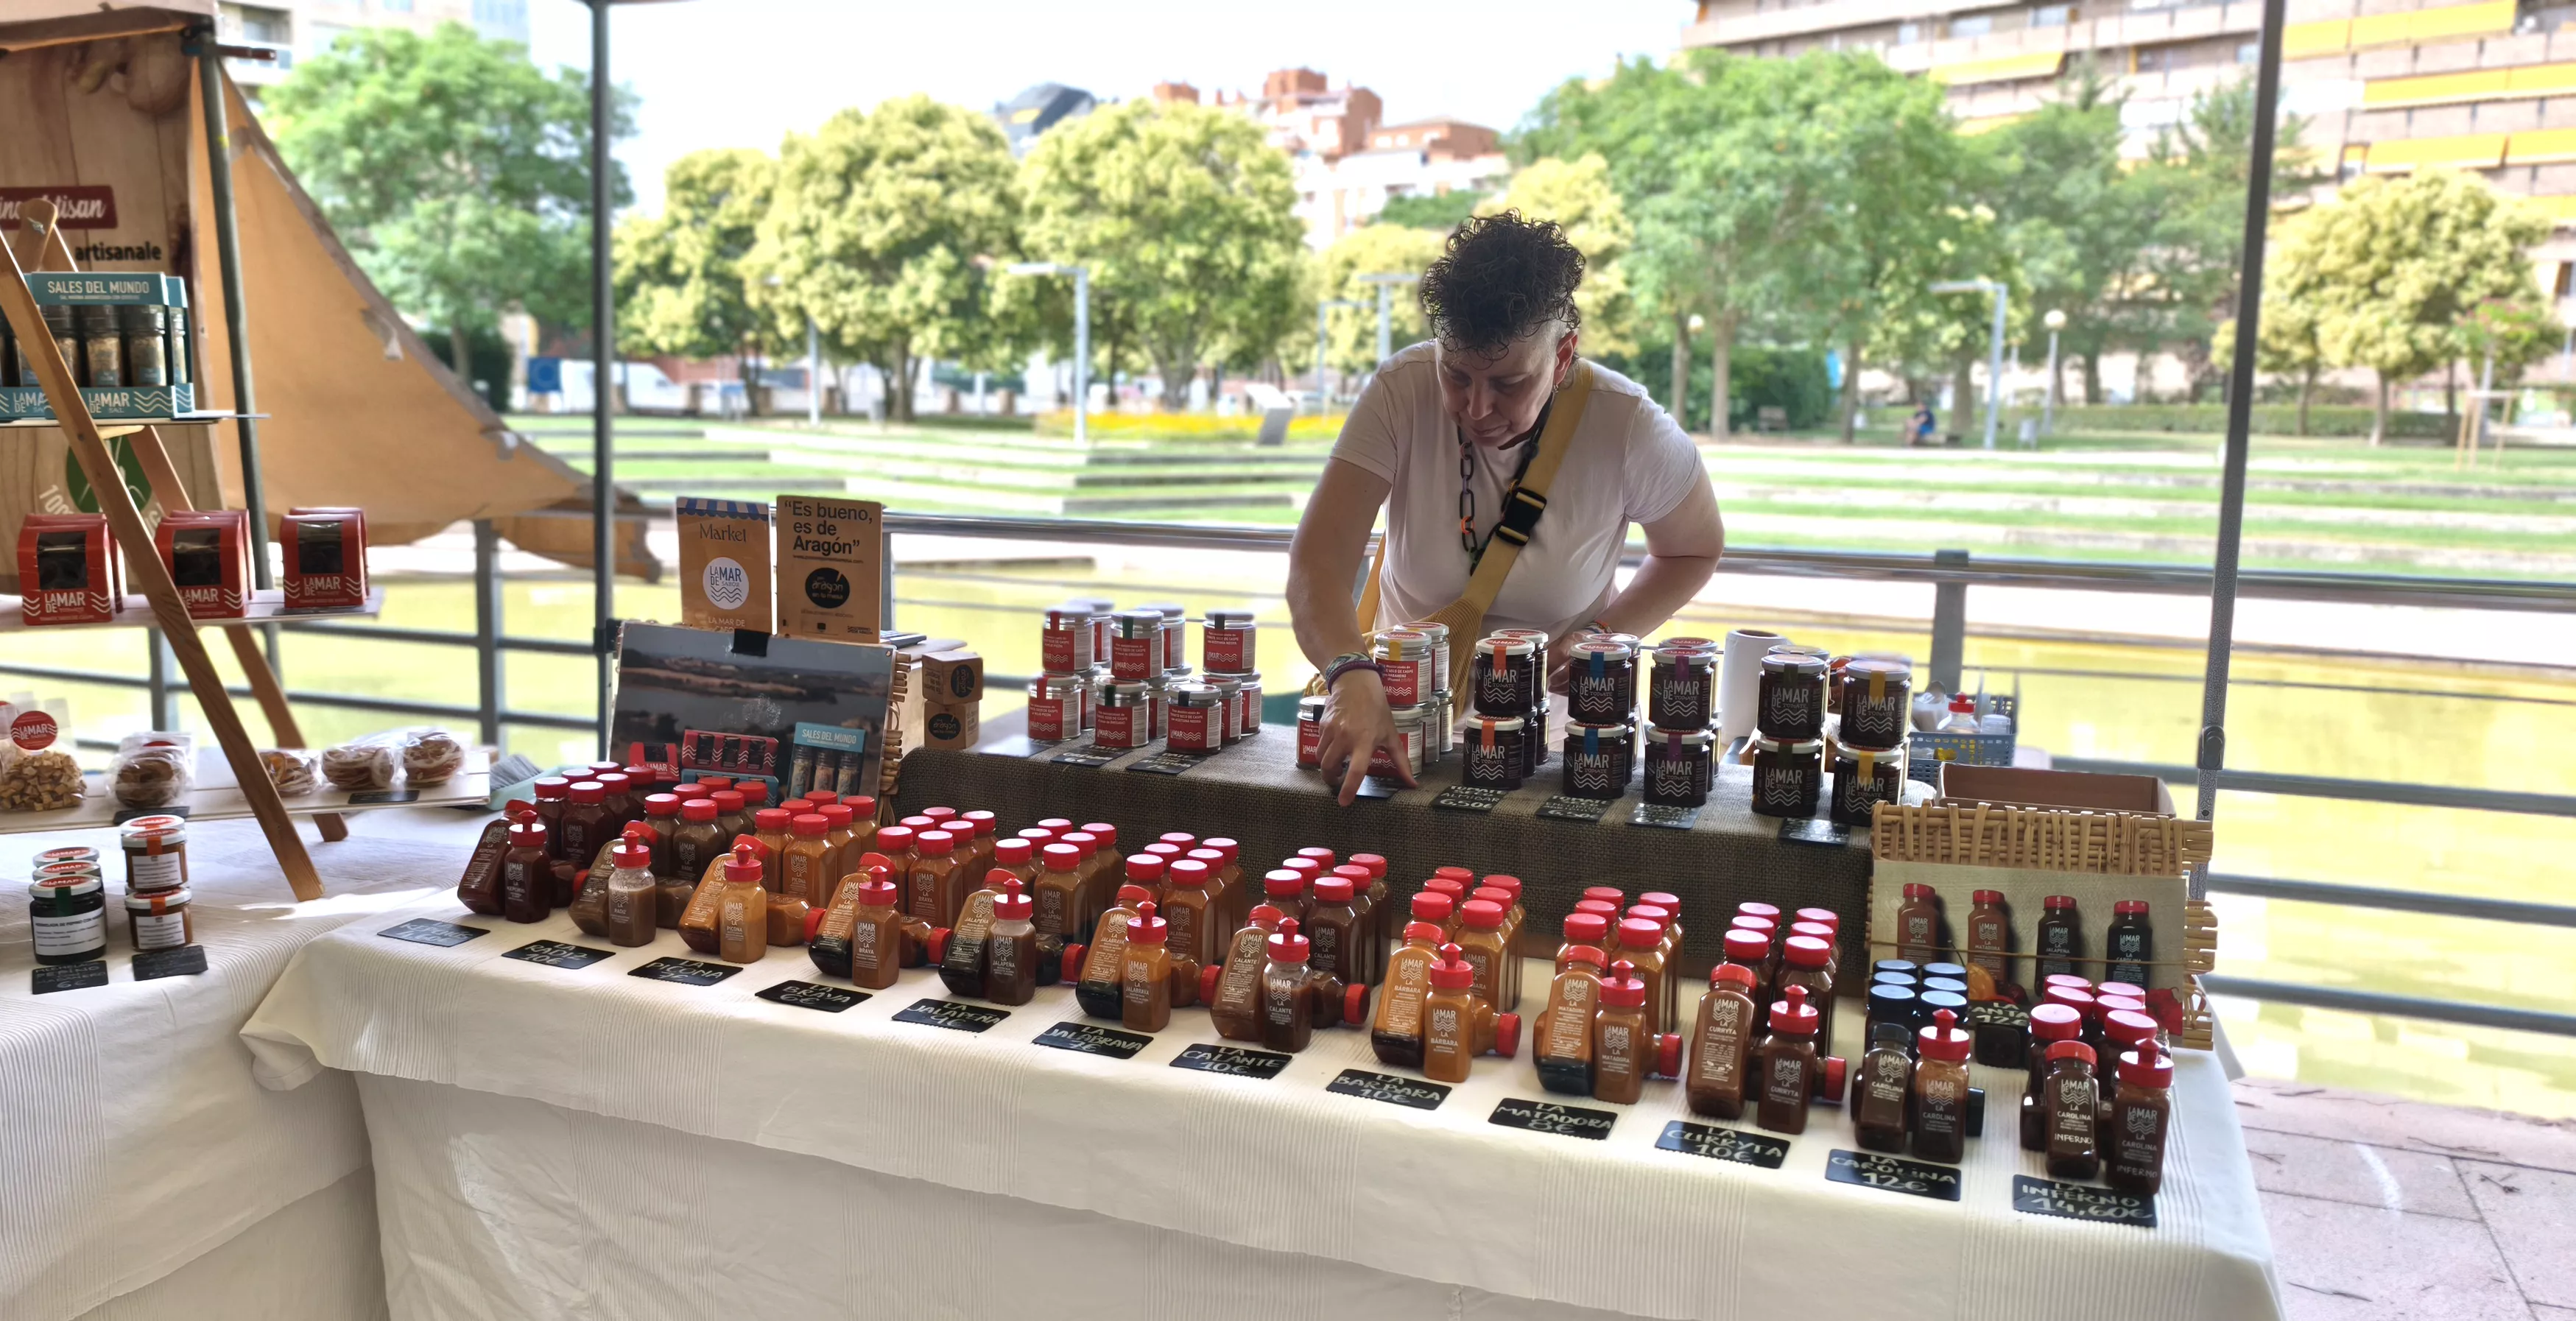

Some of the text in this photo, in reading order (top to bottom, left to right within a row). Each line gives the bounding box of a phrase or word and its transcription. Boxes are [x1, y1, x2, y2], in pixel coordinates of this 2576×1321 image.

[75, 242, 162, 261] artisanale
[48, 281, 149, 293] SALES DEL MUNDO
[99, 392, 130, 407] MAR
[817, 502, 872, 524] bueno,
[793, 521, 837, 536] es de
[710, 566, 741, 582] LA MAR
[316, 577, 340, 590] MAR
[711, 577, 719, 586] DE
[57, 592, 85, 606] MAR
[1483, 667, 1516, 683] LA MAR
[1484, 678, 1491, 688] DE
[1580, 676, 1614, 692] LA MAR
[1664, 680, 1699, 695] LA MAR
[1580, 686, 1588, 696] DE
[1664, 690, 1672, 700] DE
[1772, 687, 1809, 703] LA MAR
[1772, 698, 1781, 708] DE
[1857, 694, 1895, 712] LA MAR
[1857, 705, 1867, 716] DE
[27, 724, 48, 735] MAR
[802, 729, 856, 744] SALES DEL MUNDO
[1472, 742, 1505, 759] LA MAR
[1471, 754, 1480, 764] DE
[1574, 753, 1609, 768] LA MAR
[655, 764, 667, 772] MAR
[1574, 763, 1583, 772] DE
[1656, 759, 1692, 775] LA MAR
[1656, 769, 1666, 780] DE
[1766, 767, 1803, 784] LA MAR
[1765, 778, 1775, 788] DE
[1846, 775, 1885, 792] LA MAR
[1845, 786, 1855, 796] DE
[524, 954, 563, 965] 10€
[680, 960, 702, 968] LA
[1408, 959, 1424, 969] MAR
[646, 962, 723, 979] PICONA
[660, 971, 689, 981] 7€
[810, 984, 833, 993] LA
[1276, 979, 1291, 988] MAR
[1394, 984, 1421, 994] BÁRBARA
[782, 986, 851, 1003] BRAVA
[1125, 987, 1150, 996] JALABRAVA
[780, 994, 820, 1005] 6€
[943, 1002, 967, 1010] LA
[1269, 1006, 1292, 1015] CALANTE
[1558, 1005, 1586, 1013] MATADORA
[907, 1005, 1001, 1024] JALAPEÑA
[1967, 1007, 2030, 1018] ANTA
[931, 1015, 967, 1027] 9€
[1081, 1026, 1104, 1035] LA
[1708, 1026, 1736, 1035] CURRYTA
[1044, 1029, 1143, 1051] JALABRAVA
[1431, 1036, 1458, 1047] BÁRBARA
[1069, 1041, 1102, 1052] 7€
[1219, 1047, 1244, 1056] LA
[1182, 1051, 1284, 1068] CALANTE
[1602, 1054, 1630, 1063] MATADORA
[1199, 1062, 1250, 1074] 10€
[1376, 1074, 1404, 1085] LA
[1335, 1076, 1440, 1101] BÁRBARA
[1770, 1085, 1798, 1097] CURRYTA
[1872, 1081, 1904, 1093] CAROLINA
[1360, 1088, 1411, 1104] 10€
[1535, 1103, 1566, 1113] LA
[1496, 1107, 1612, 1130] MATADORA
[1923, 1112, 1956, 1122] CAROLINA
[2057, 1111, 2091, 1121] CAROLINA
[1527, 1119, 1577, 1134] 8€
[1707, 1127, 1736, 1138] LA
[2054, 1132, 2092, 1144] INFERNO
[1667, 1130, 1782, 1158] CURRYTA
[2122, 1141, 2157, 1151] CAROLINA
[1697, 1144, 1753, 1162] 10€
[1871, 1155, 1899, 1166] LA
[2116, 1165, 2158, 1178] INFERNO
[1863, 1172, 1929, 1192] 12€
[2055, 1183, 2086, 1193] LA
[2022, 1185, 2140, 1207] INFERNO
[2030, 1197, 2153, 1218] 14,60€
